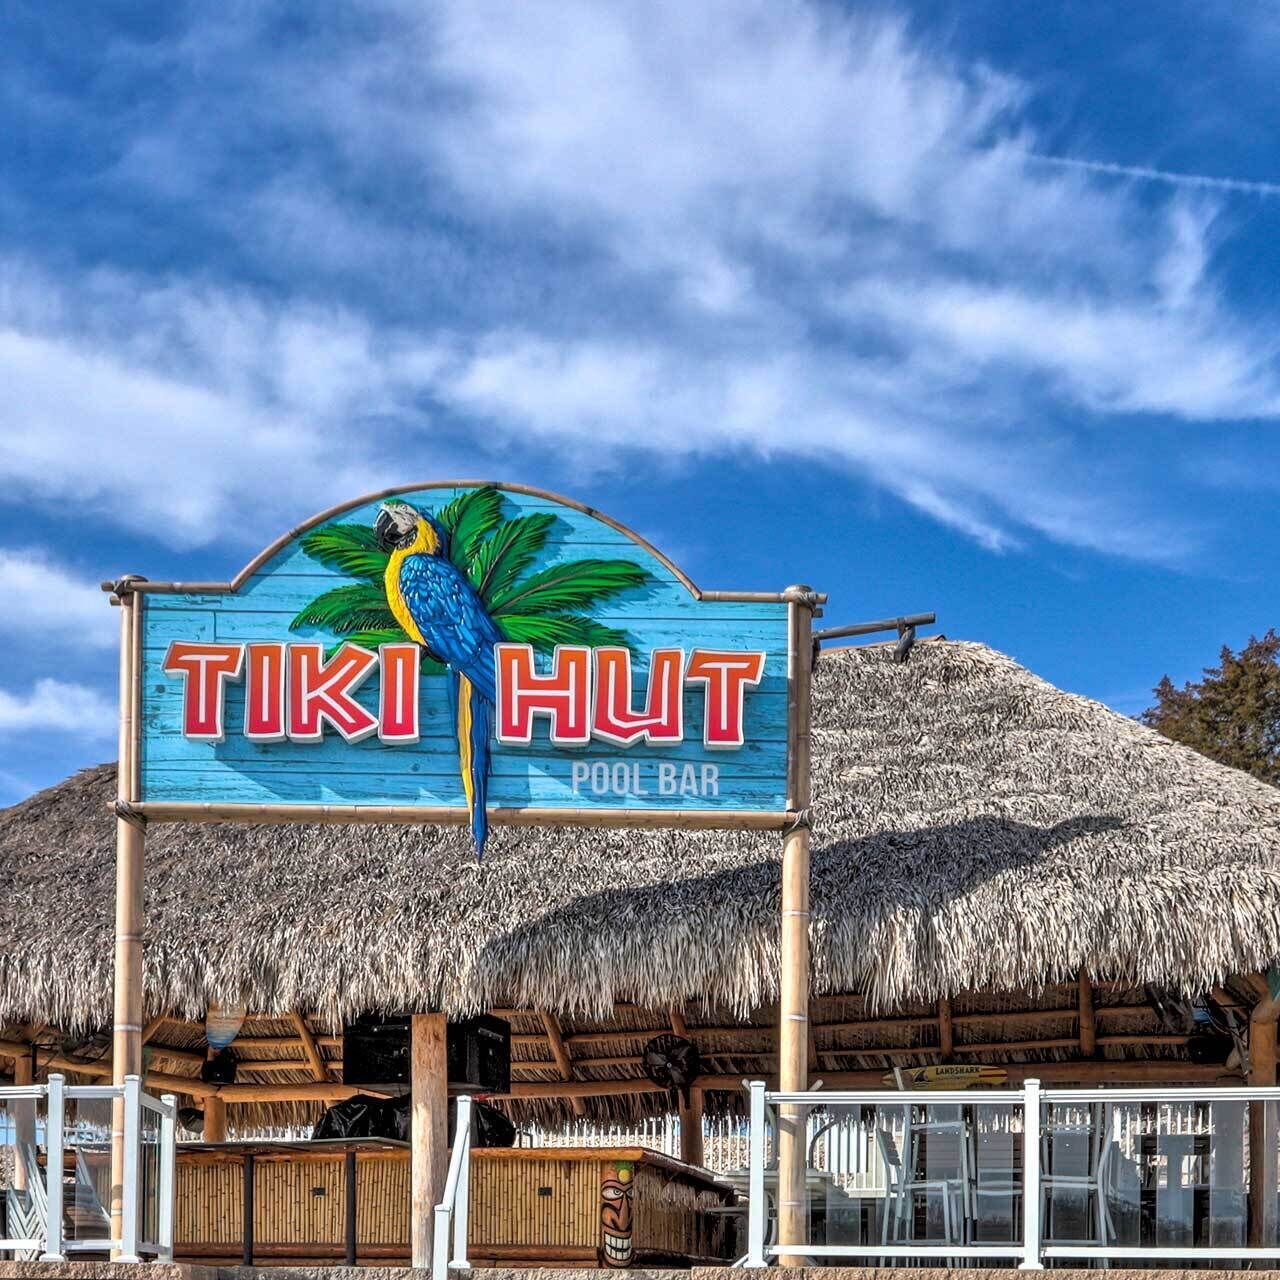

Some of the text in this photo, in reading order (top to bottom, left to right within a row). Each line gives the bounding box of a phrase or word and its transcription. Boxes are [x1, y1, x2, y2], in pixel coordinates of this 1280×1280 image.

[162, 640, 765, 750] TIKI HUT
[571, 761, 720, 797] POOL BAR
[936, 1067, 980, 1075] LANDSHARK
